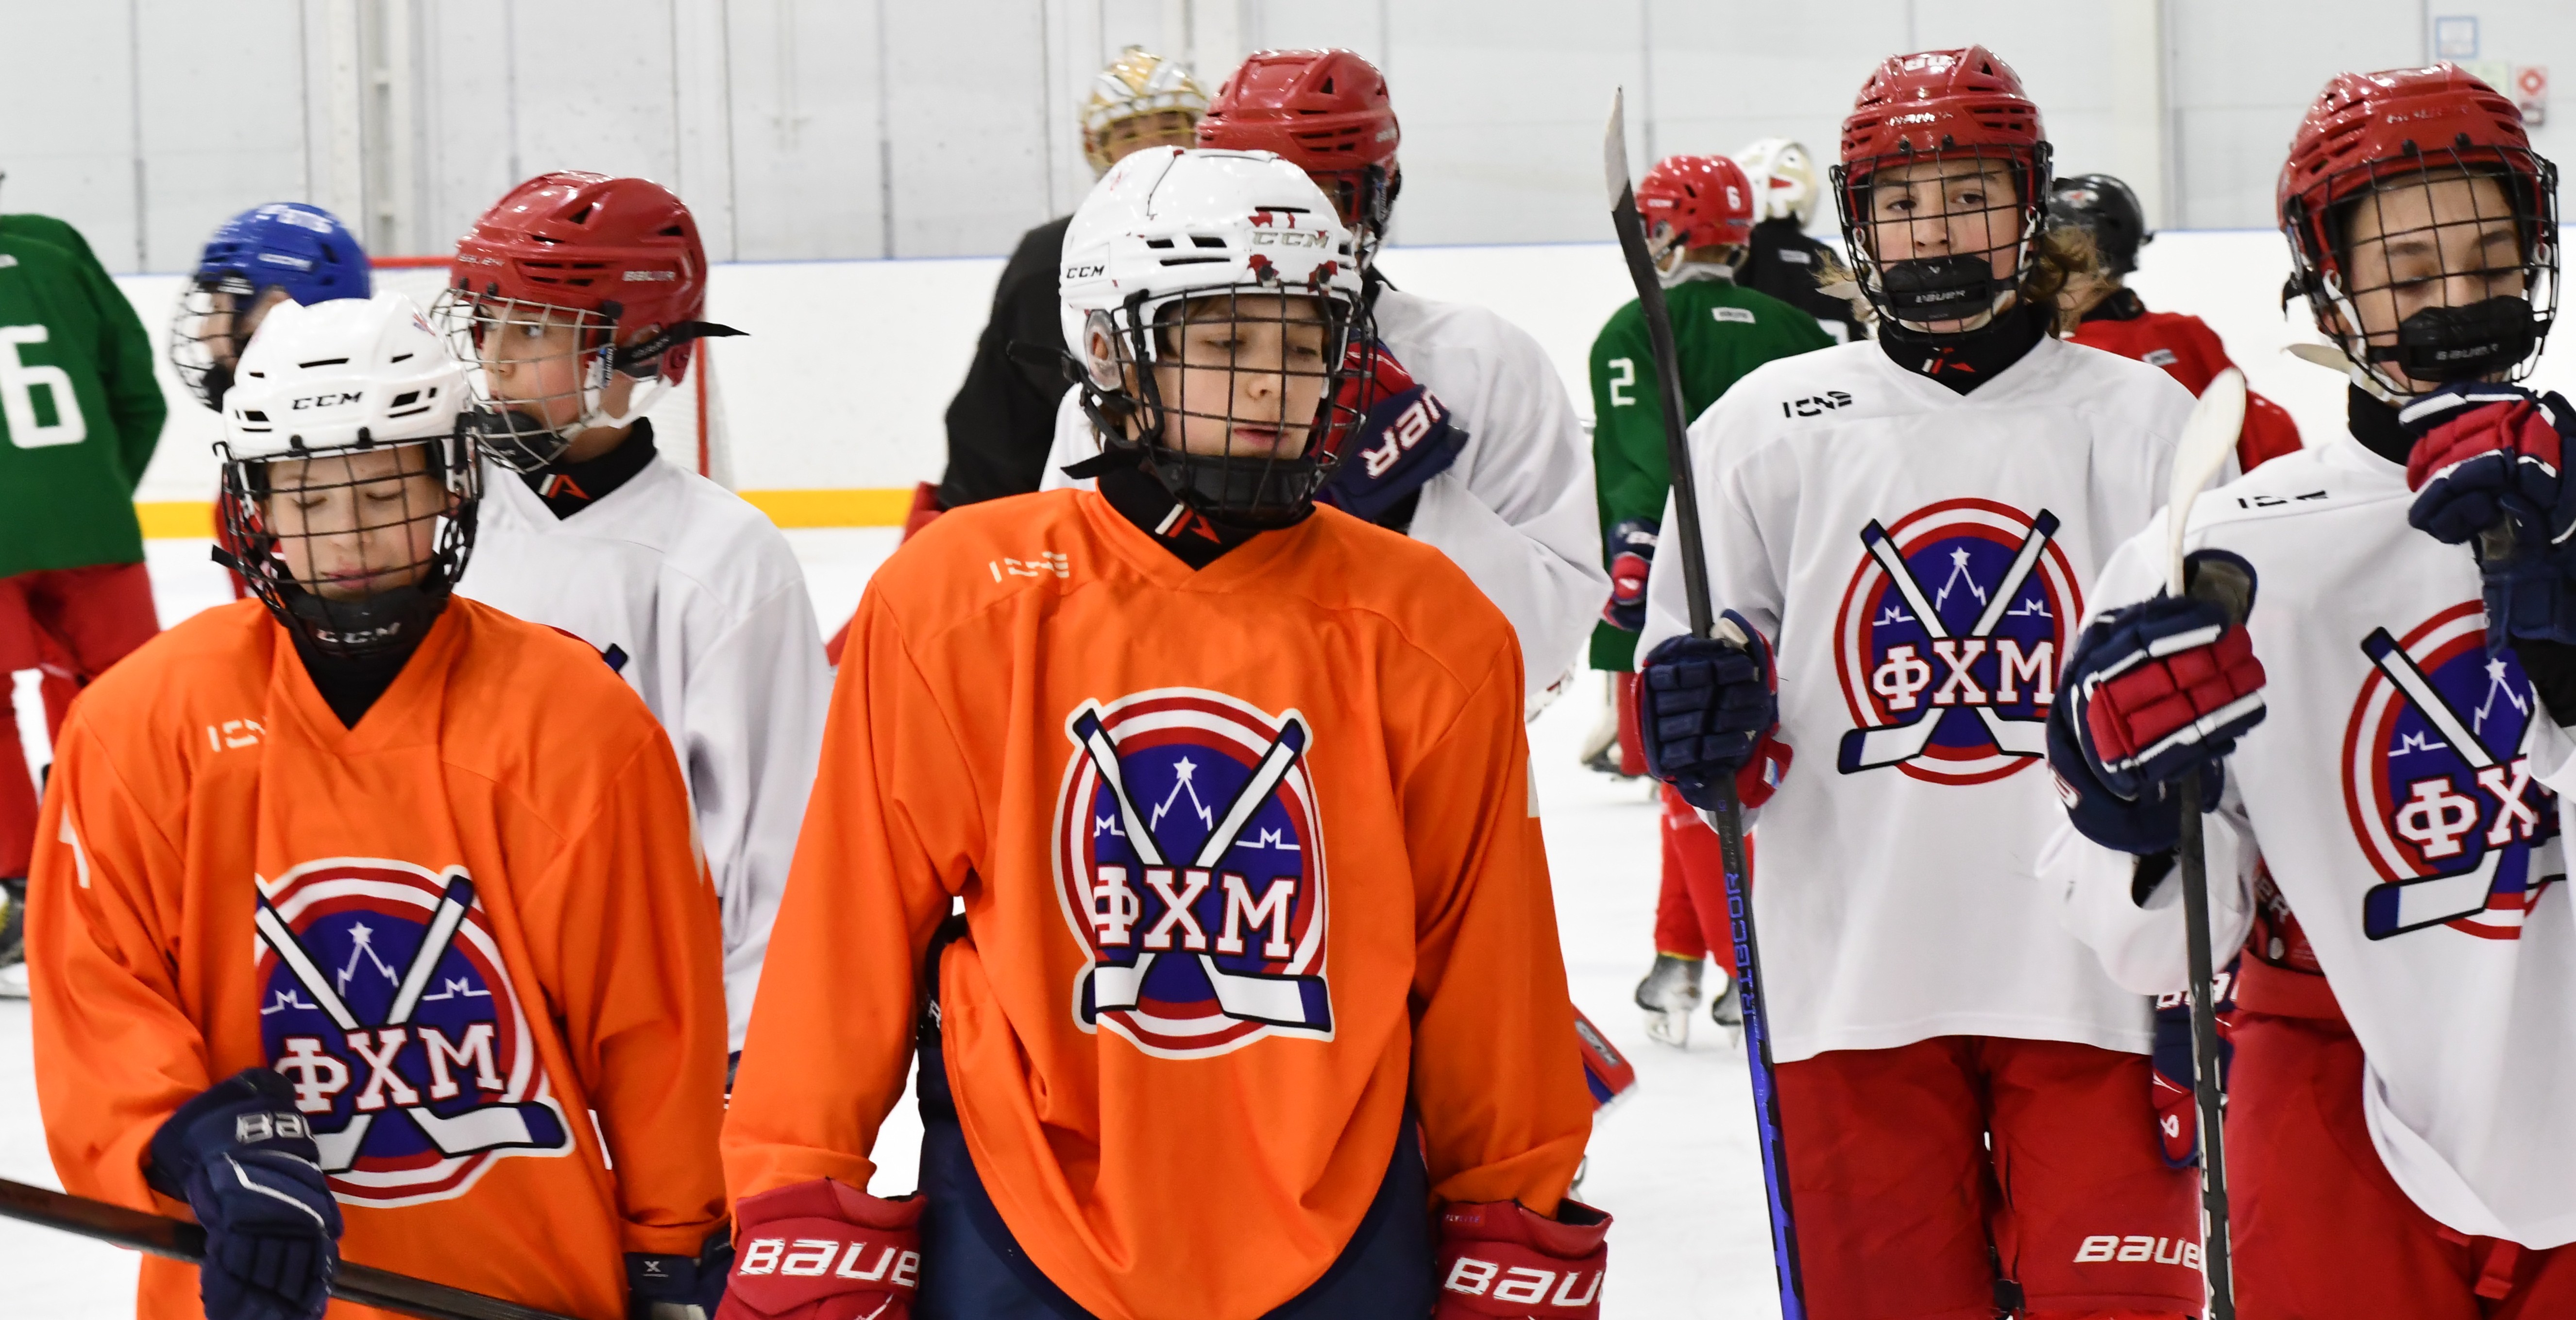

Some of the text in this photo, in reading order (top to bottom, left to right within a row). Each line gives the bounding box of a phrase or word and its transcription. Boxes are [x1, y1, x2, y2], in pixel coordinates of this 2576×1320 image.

[1726, 185, 1742, 210] 6
[1066, 265, 1105, 279] CCM
[1252, 231, 1330, 249] CCM
[0, 324, 87, 449] 6
[291, 391, 364, 411] CCM
[1609, 358, 1636, 407] 2
[1872, 635, 2055, 711] ФХМ
[2395, 758, 2559, 861] ФХ
[1093, 865, 1297, 959] ФХМ
[1726, 872, 1756, 1016] RIBCOR
[273, 1021, 506, 1114] ФХМ
